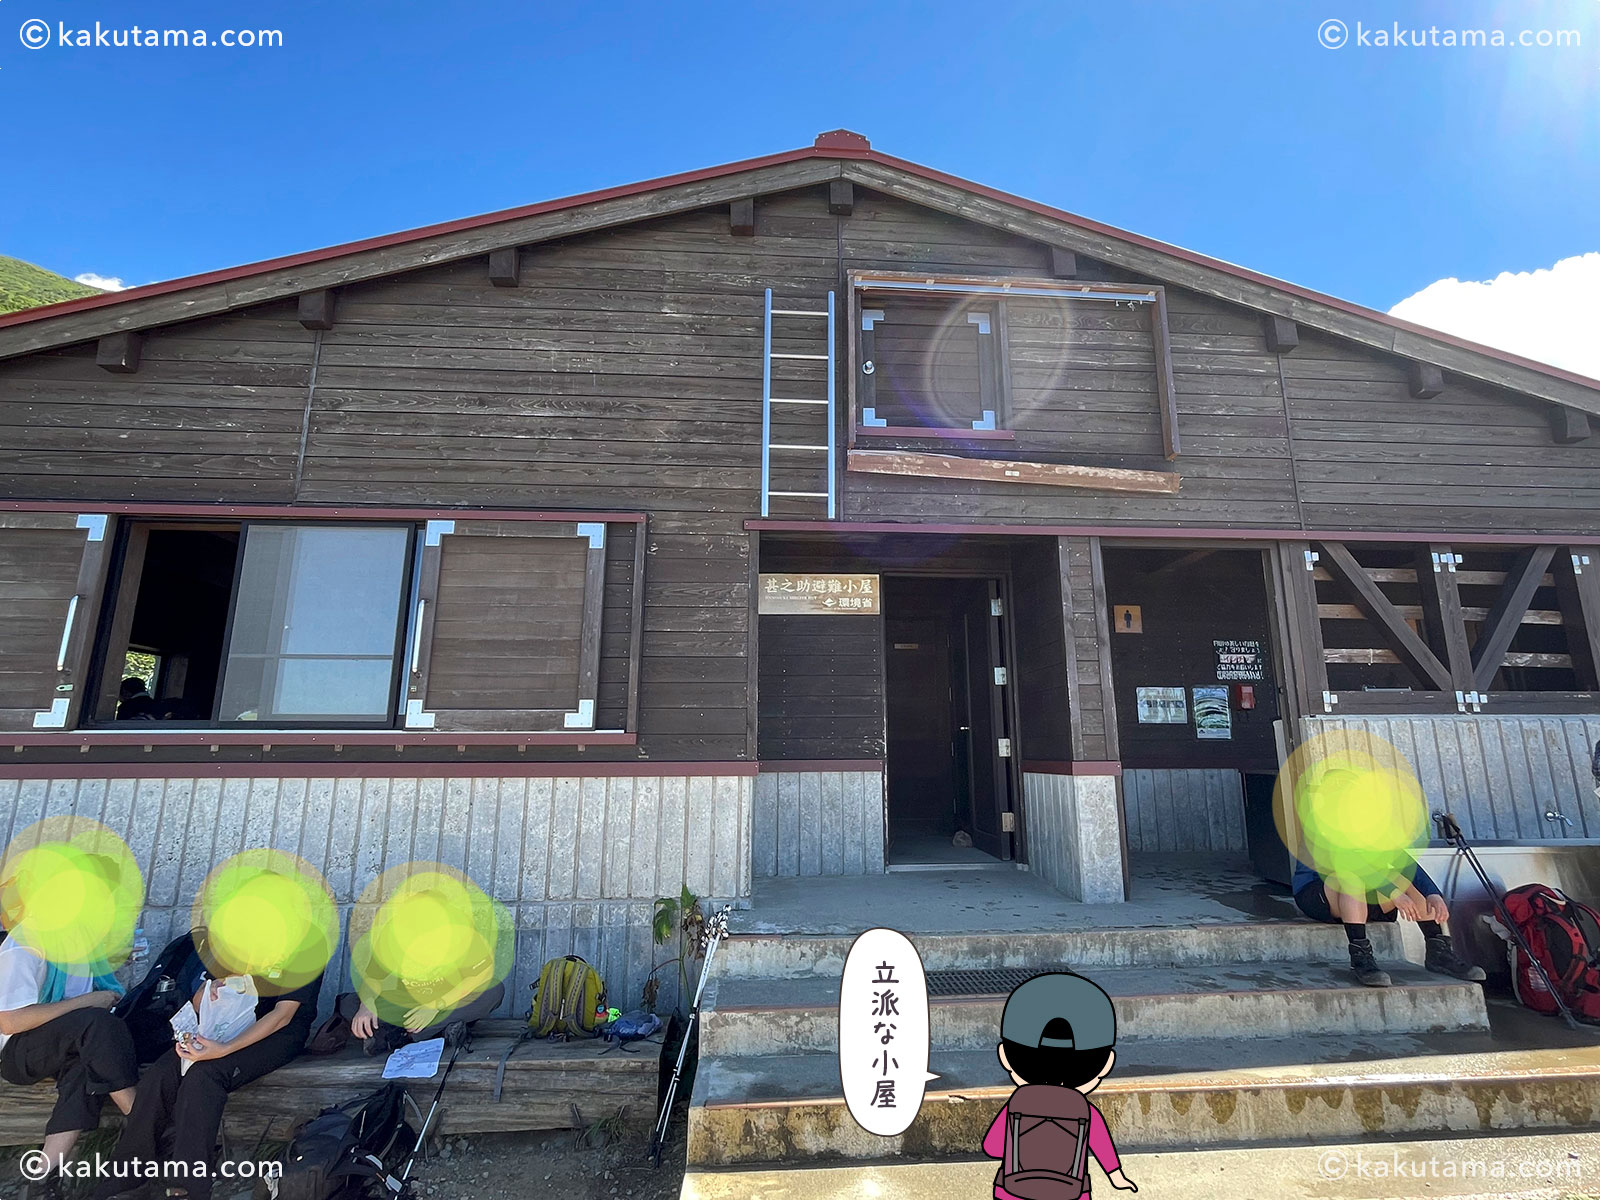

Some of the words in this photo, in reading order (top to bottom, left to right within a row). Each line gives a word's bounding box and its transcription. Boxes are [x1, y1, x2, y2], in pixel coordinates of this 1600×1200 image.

[764, 578, 873, 594] 甚之助避難小屋
[838, 597, 873, 608] 環境省
